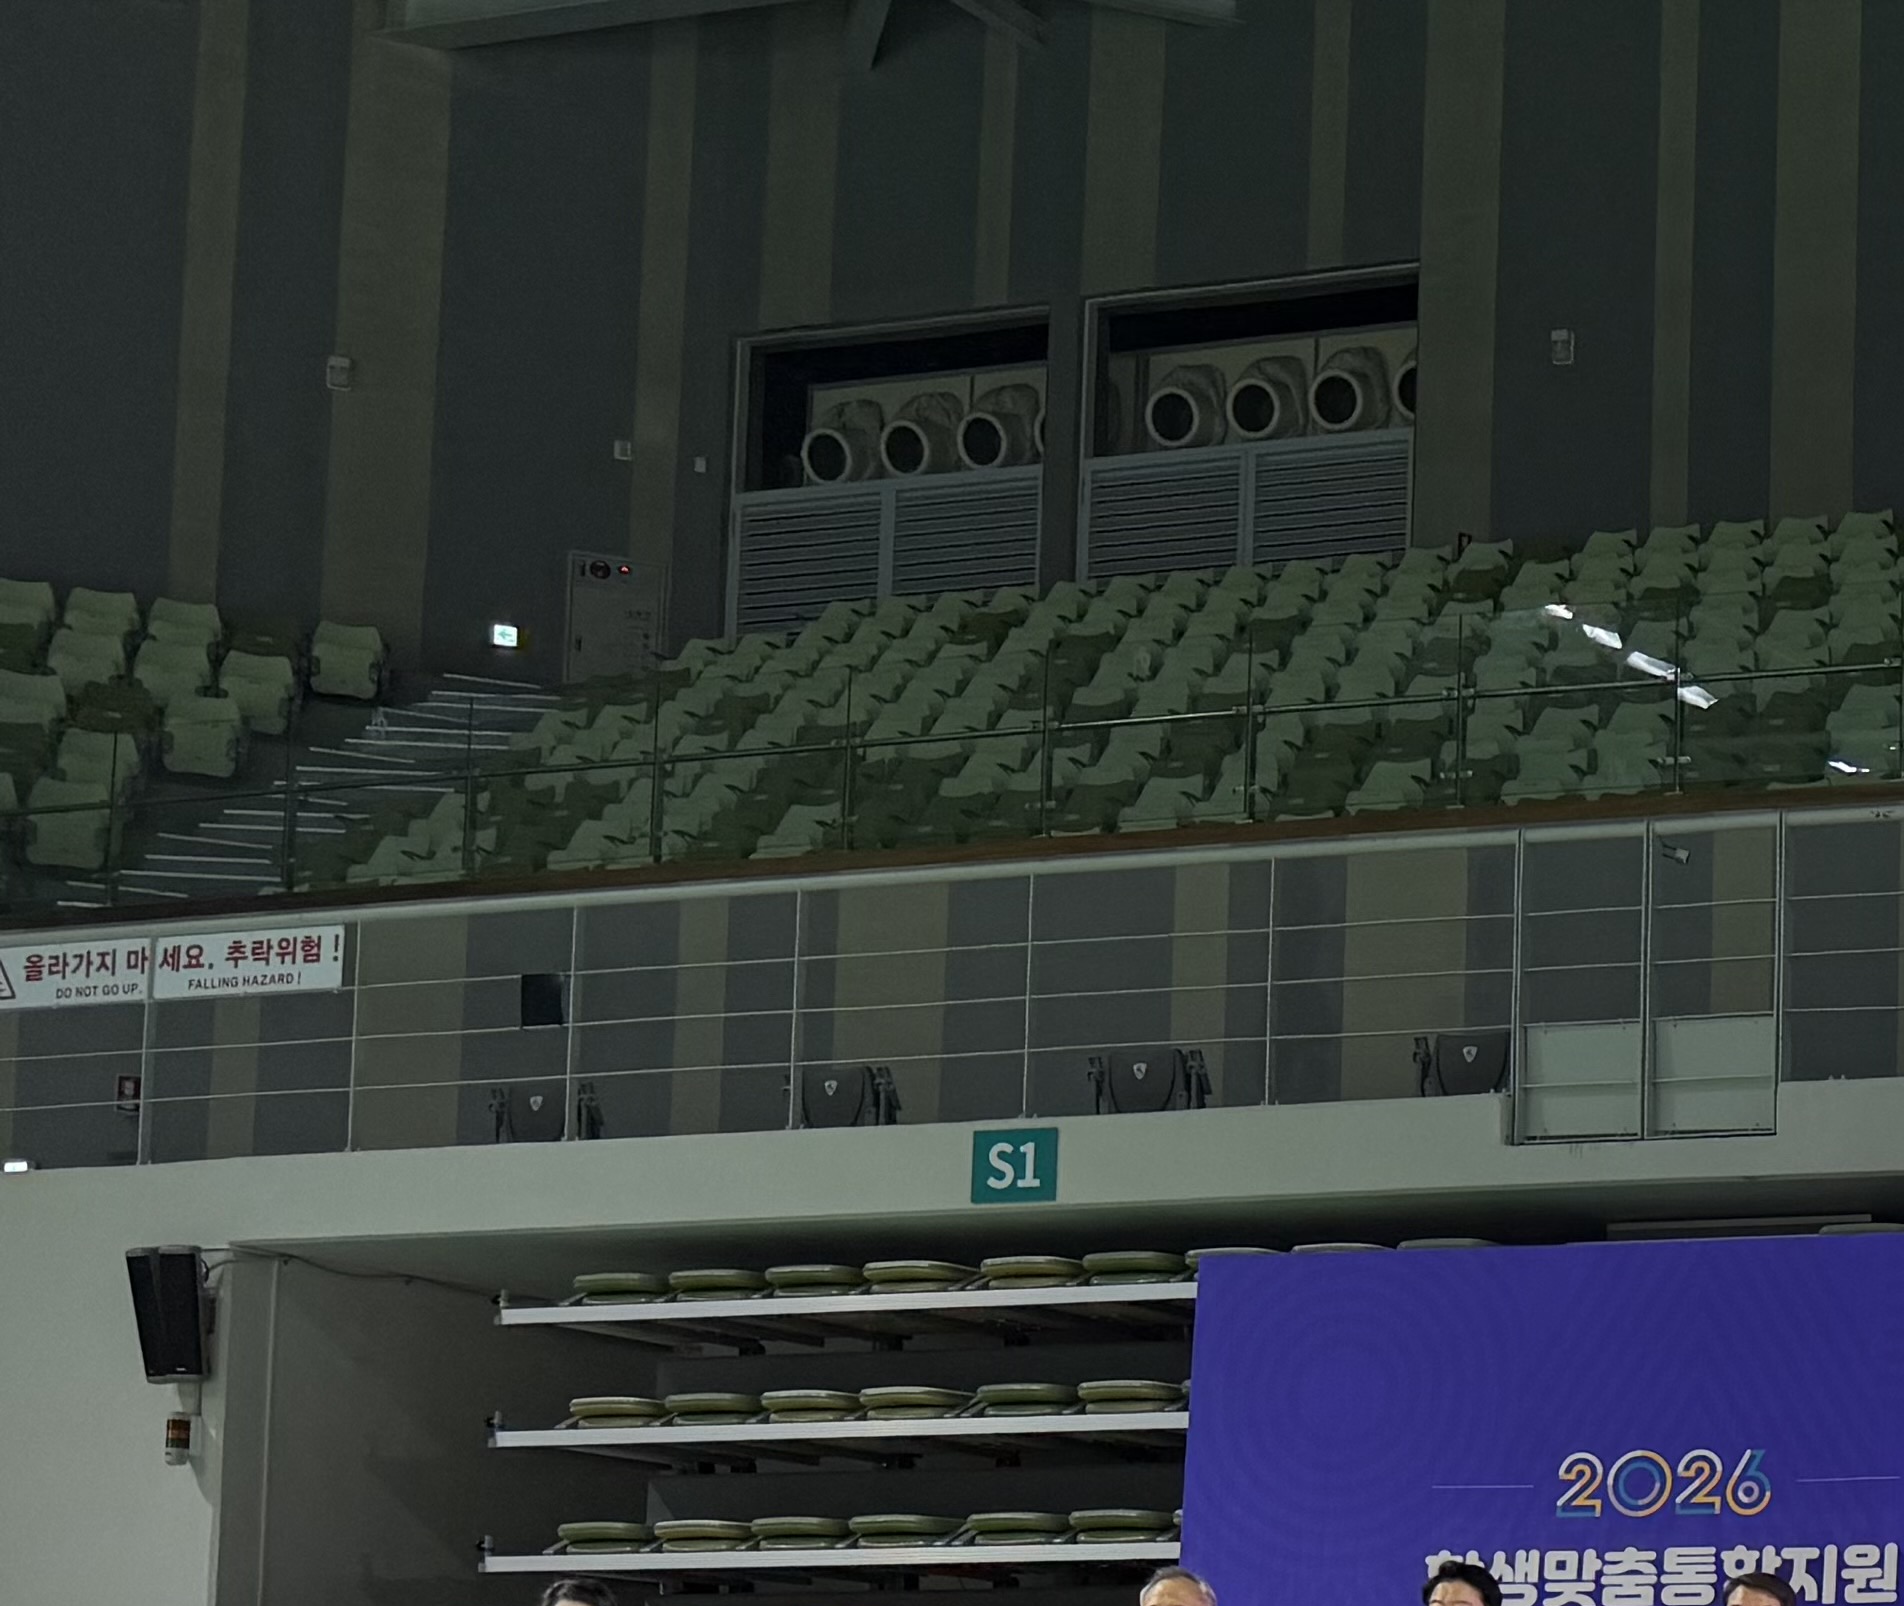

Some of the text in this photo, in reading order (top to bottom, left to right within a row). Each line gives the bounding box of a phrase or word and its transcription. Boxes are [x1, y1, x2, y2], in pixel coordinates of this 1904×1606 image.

[24, 949, 118, 982] 올라가지
[225, 936, 322, 969] 추락위험
[55, 988, 73, 999] DO
[75, 986, 98, 998] NOT
[102, 985, 120, 996] GO
[187, 976, 240, 991] FALLING
[242, 973, 294, 987] HAZARD
[986, 1142, 1043, 1189] S1
[1556, 1448, 1772, 1518] 2026
